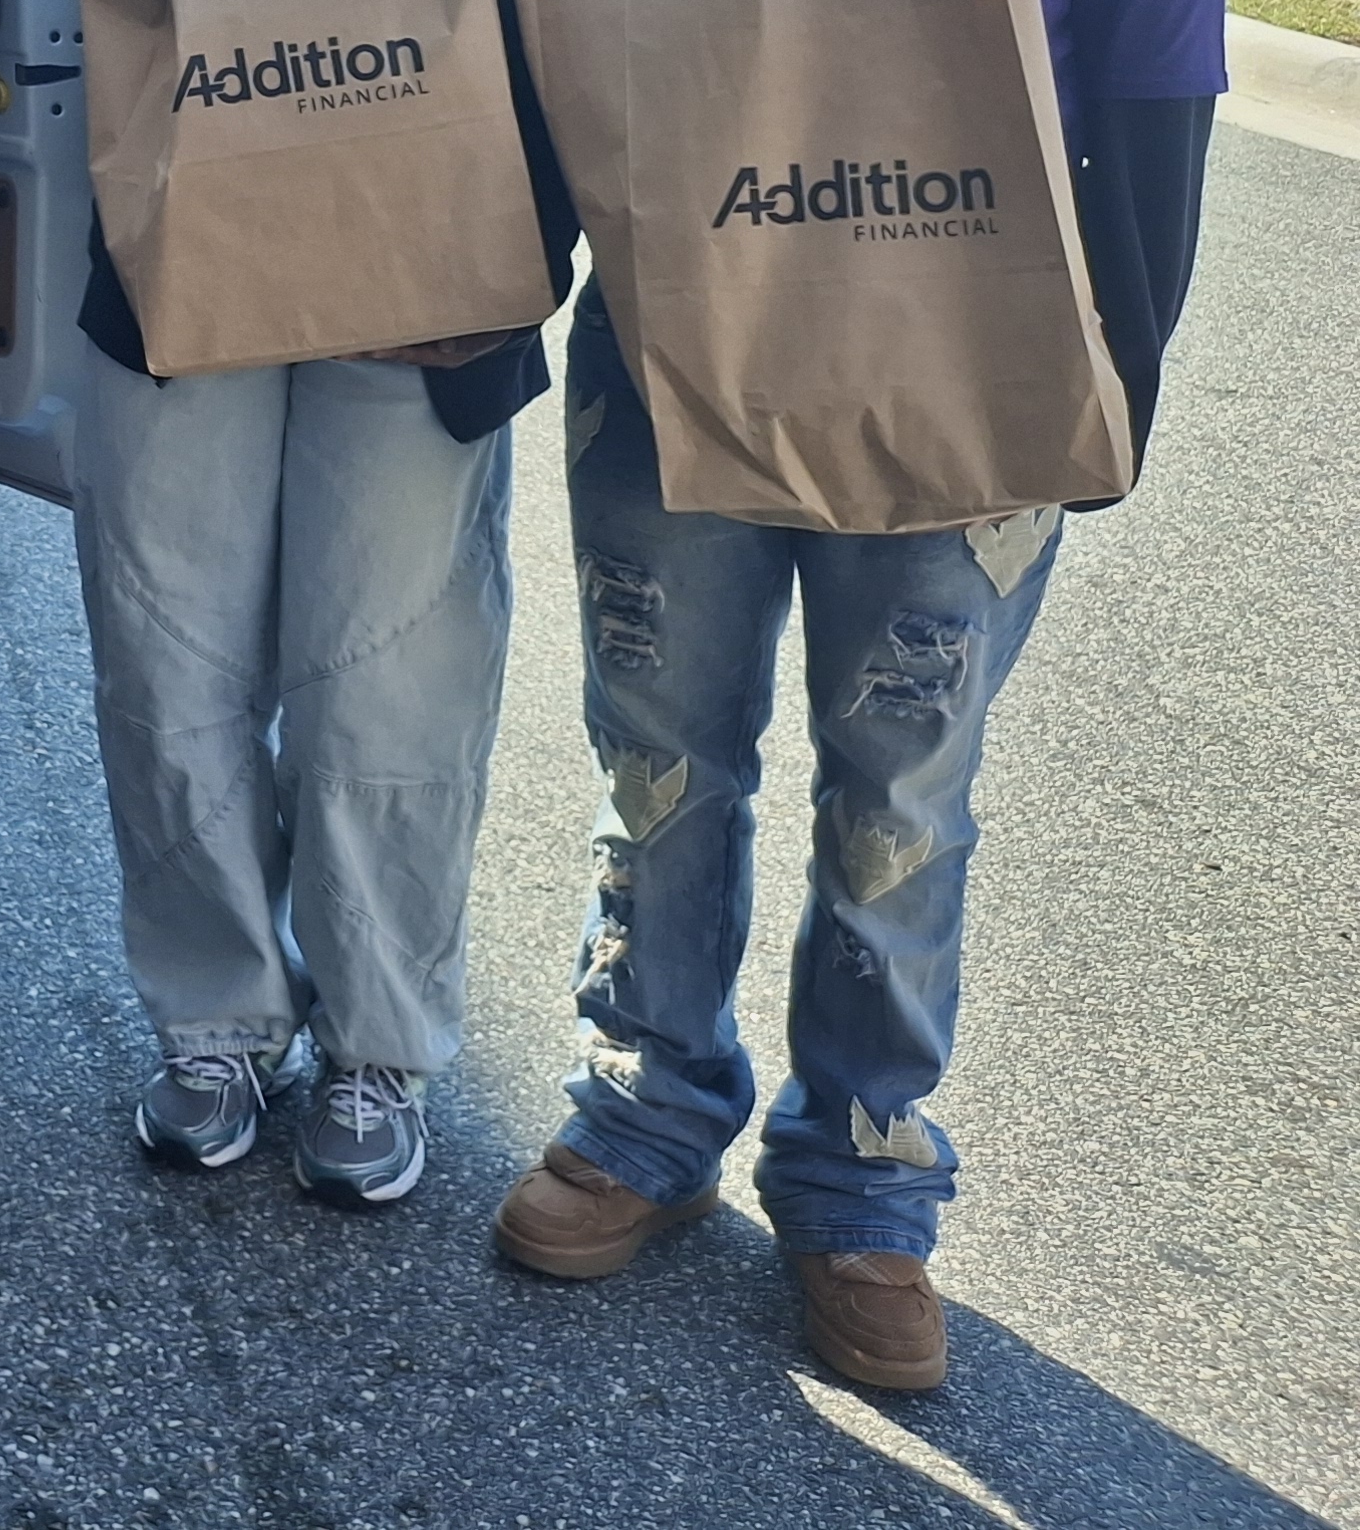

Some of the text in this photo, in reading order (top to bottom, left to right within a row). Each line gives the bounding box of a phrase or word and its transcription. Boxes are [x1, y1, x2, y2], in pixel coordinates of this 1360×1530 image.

[171, 36, 426, 114] Addition
[297, 79, 431, 114] FINANCIAL
[712, 159, 996, 229] Addition
[853, 217, 1000, 242] FINANCIAL
